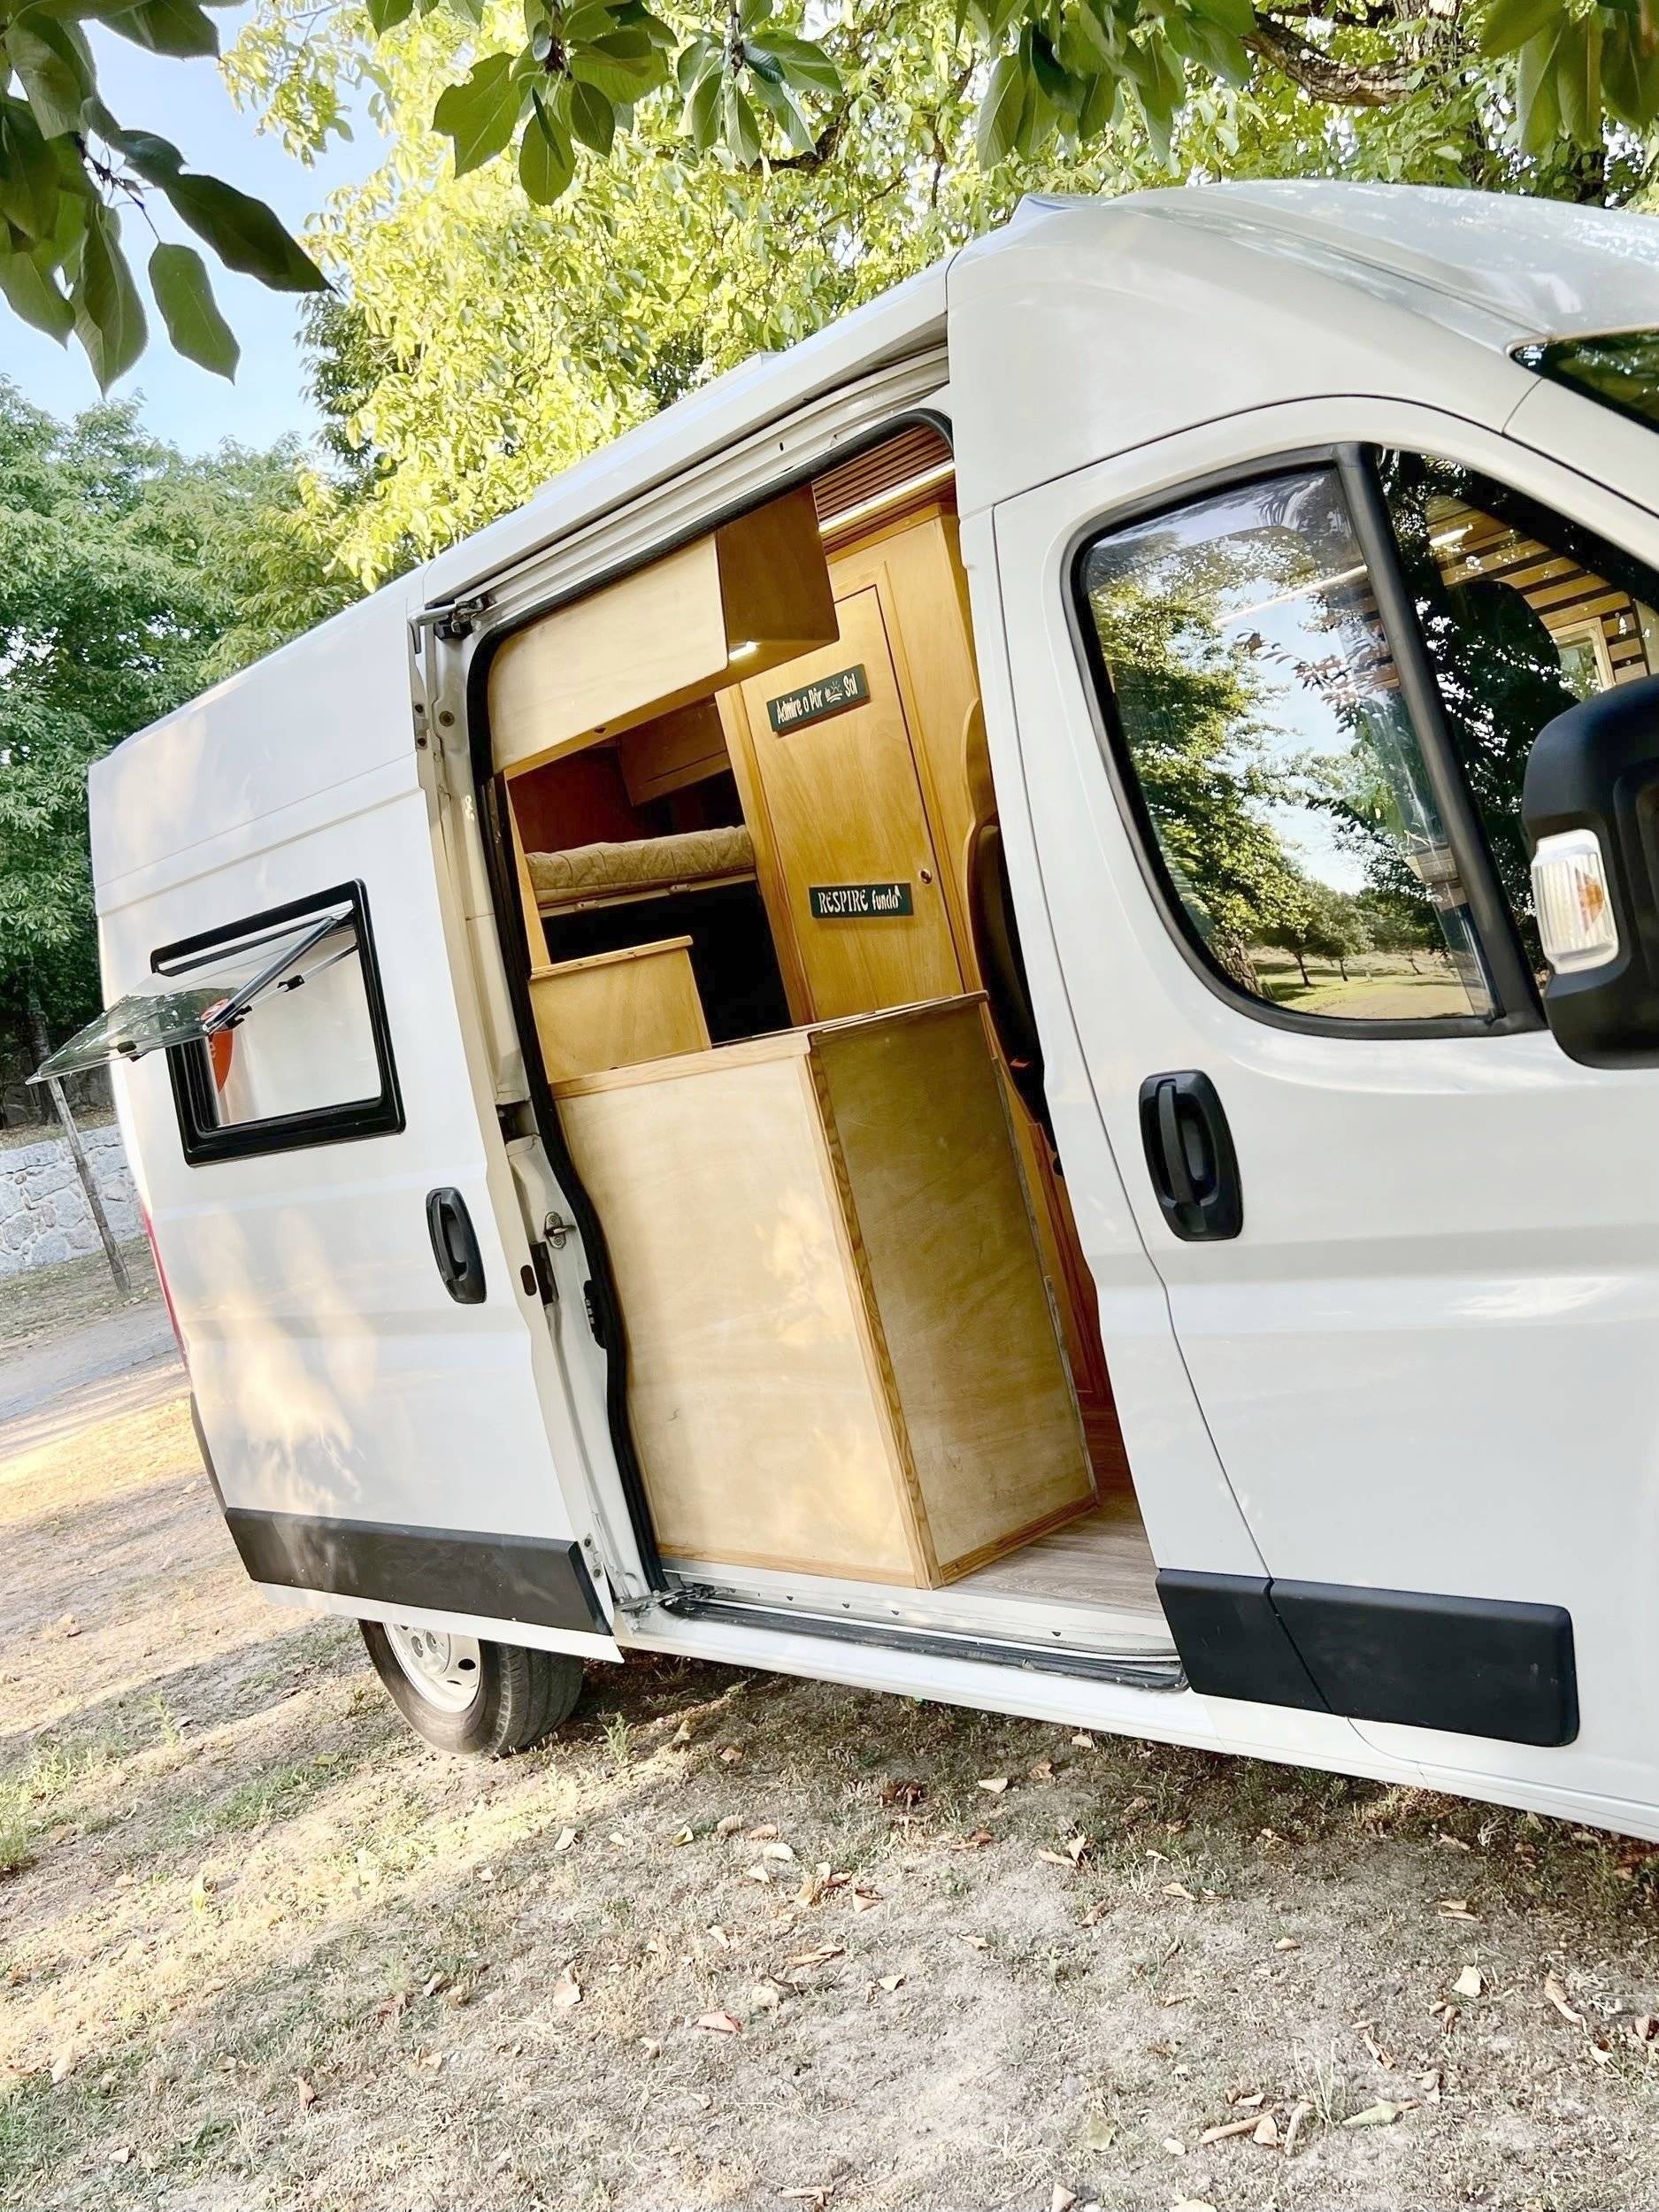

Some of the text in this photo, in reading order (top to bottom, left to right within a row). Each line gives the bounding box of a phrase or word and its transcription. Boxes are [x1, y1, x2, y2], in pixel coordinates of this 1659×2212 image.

[776, 697, 803, 724] Admire
[803, 695, 810, 712] o
[843, 673, 858, 697] Sol
[818, 888, 899, 913] RESPIRE fundo
